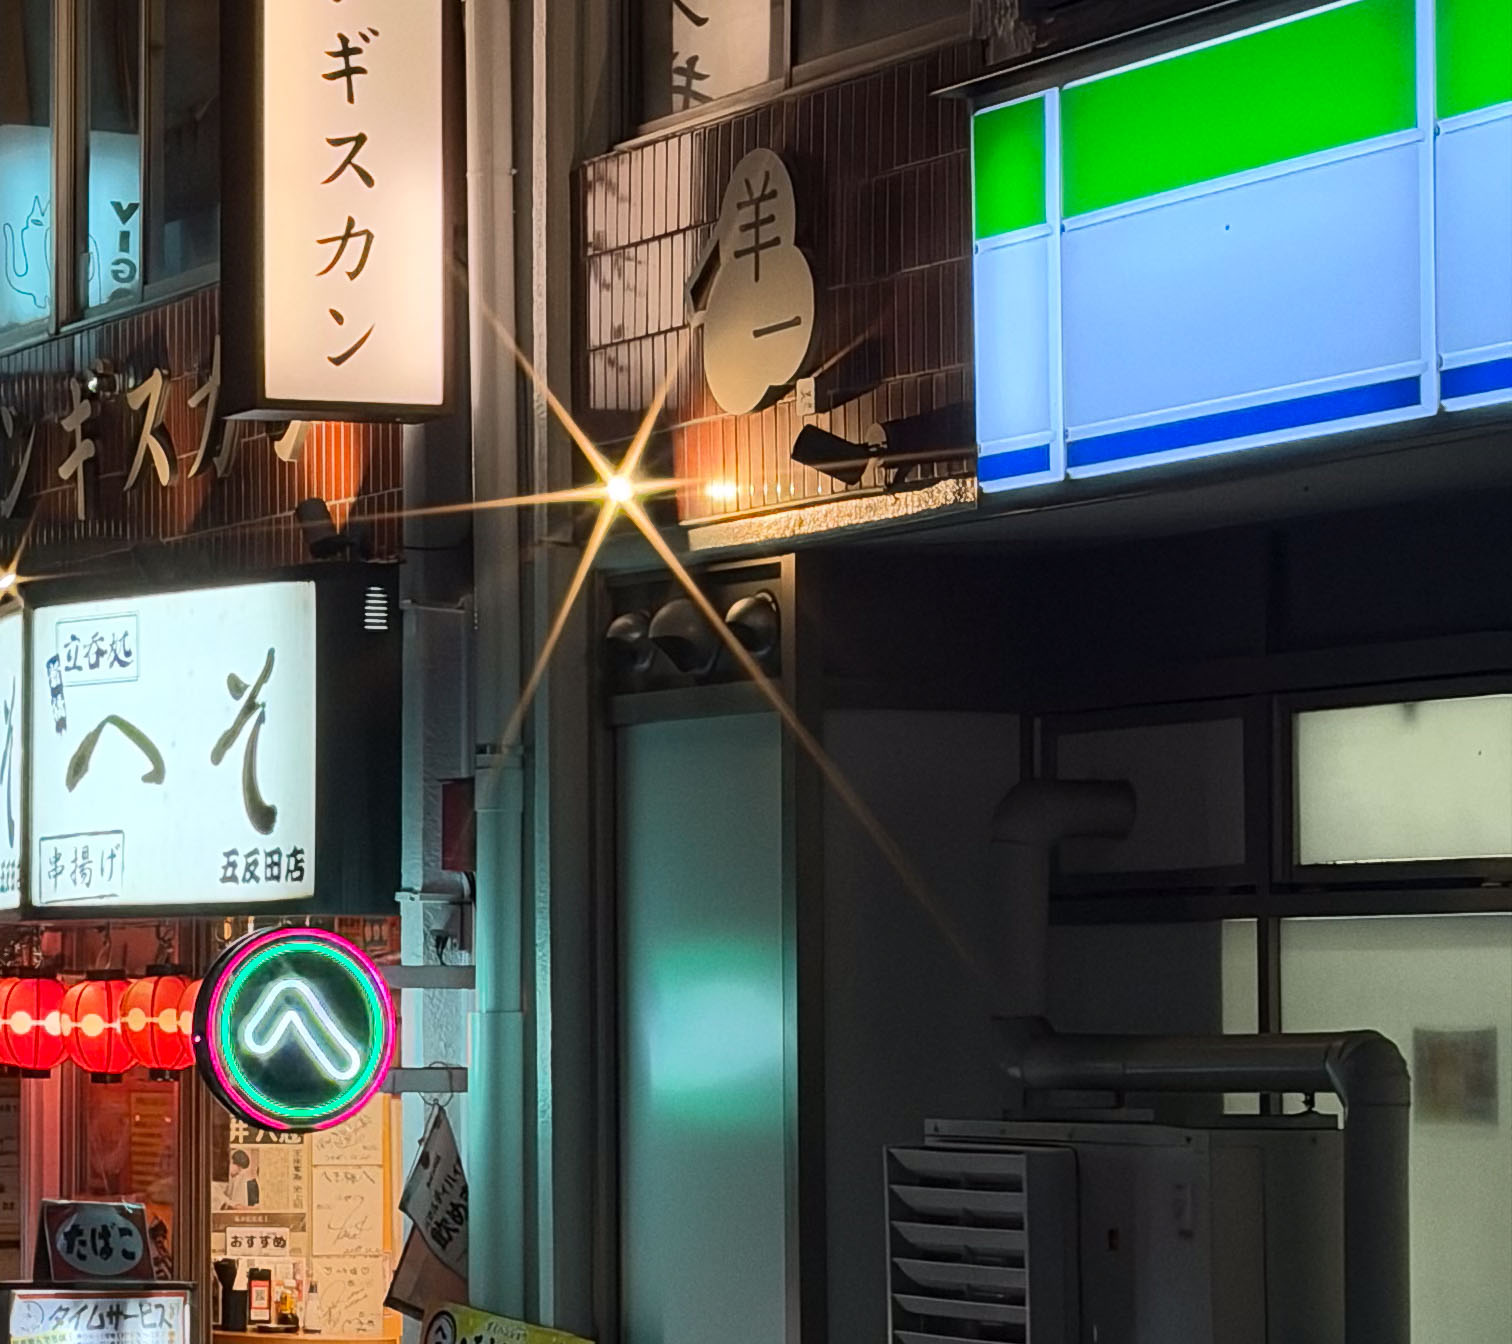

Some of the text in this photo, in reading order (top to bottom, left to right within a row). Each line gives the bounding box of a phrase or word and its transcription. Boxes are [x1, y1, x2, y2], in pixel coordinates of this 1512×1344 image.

[734, 169, 802, 338] 羊一
[66, 647, 278, 835] へそ
[47, 843, 306, 892] 串揚げ 五反田店
[63, 1222, 136, 1261] たばこ
[231, 1235, 287, 1248] おすすめ
[49, 1303, 174, 1332] タイムサービス
